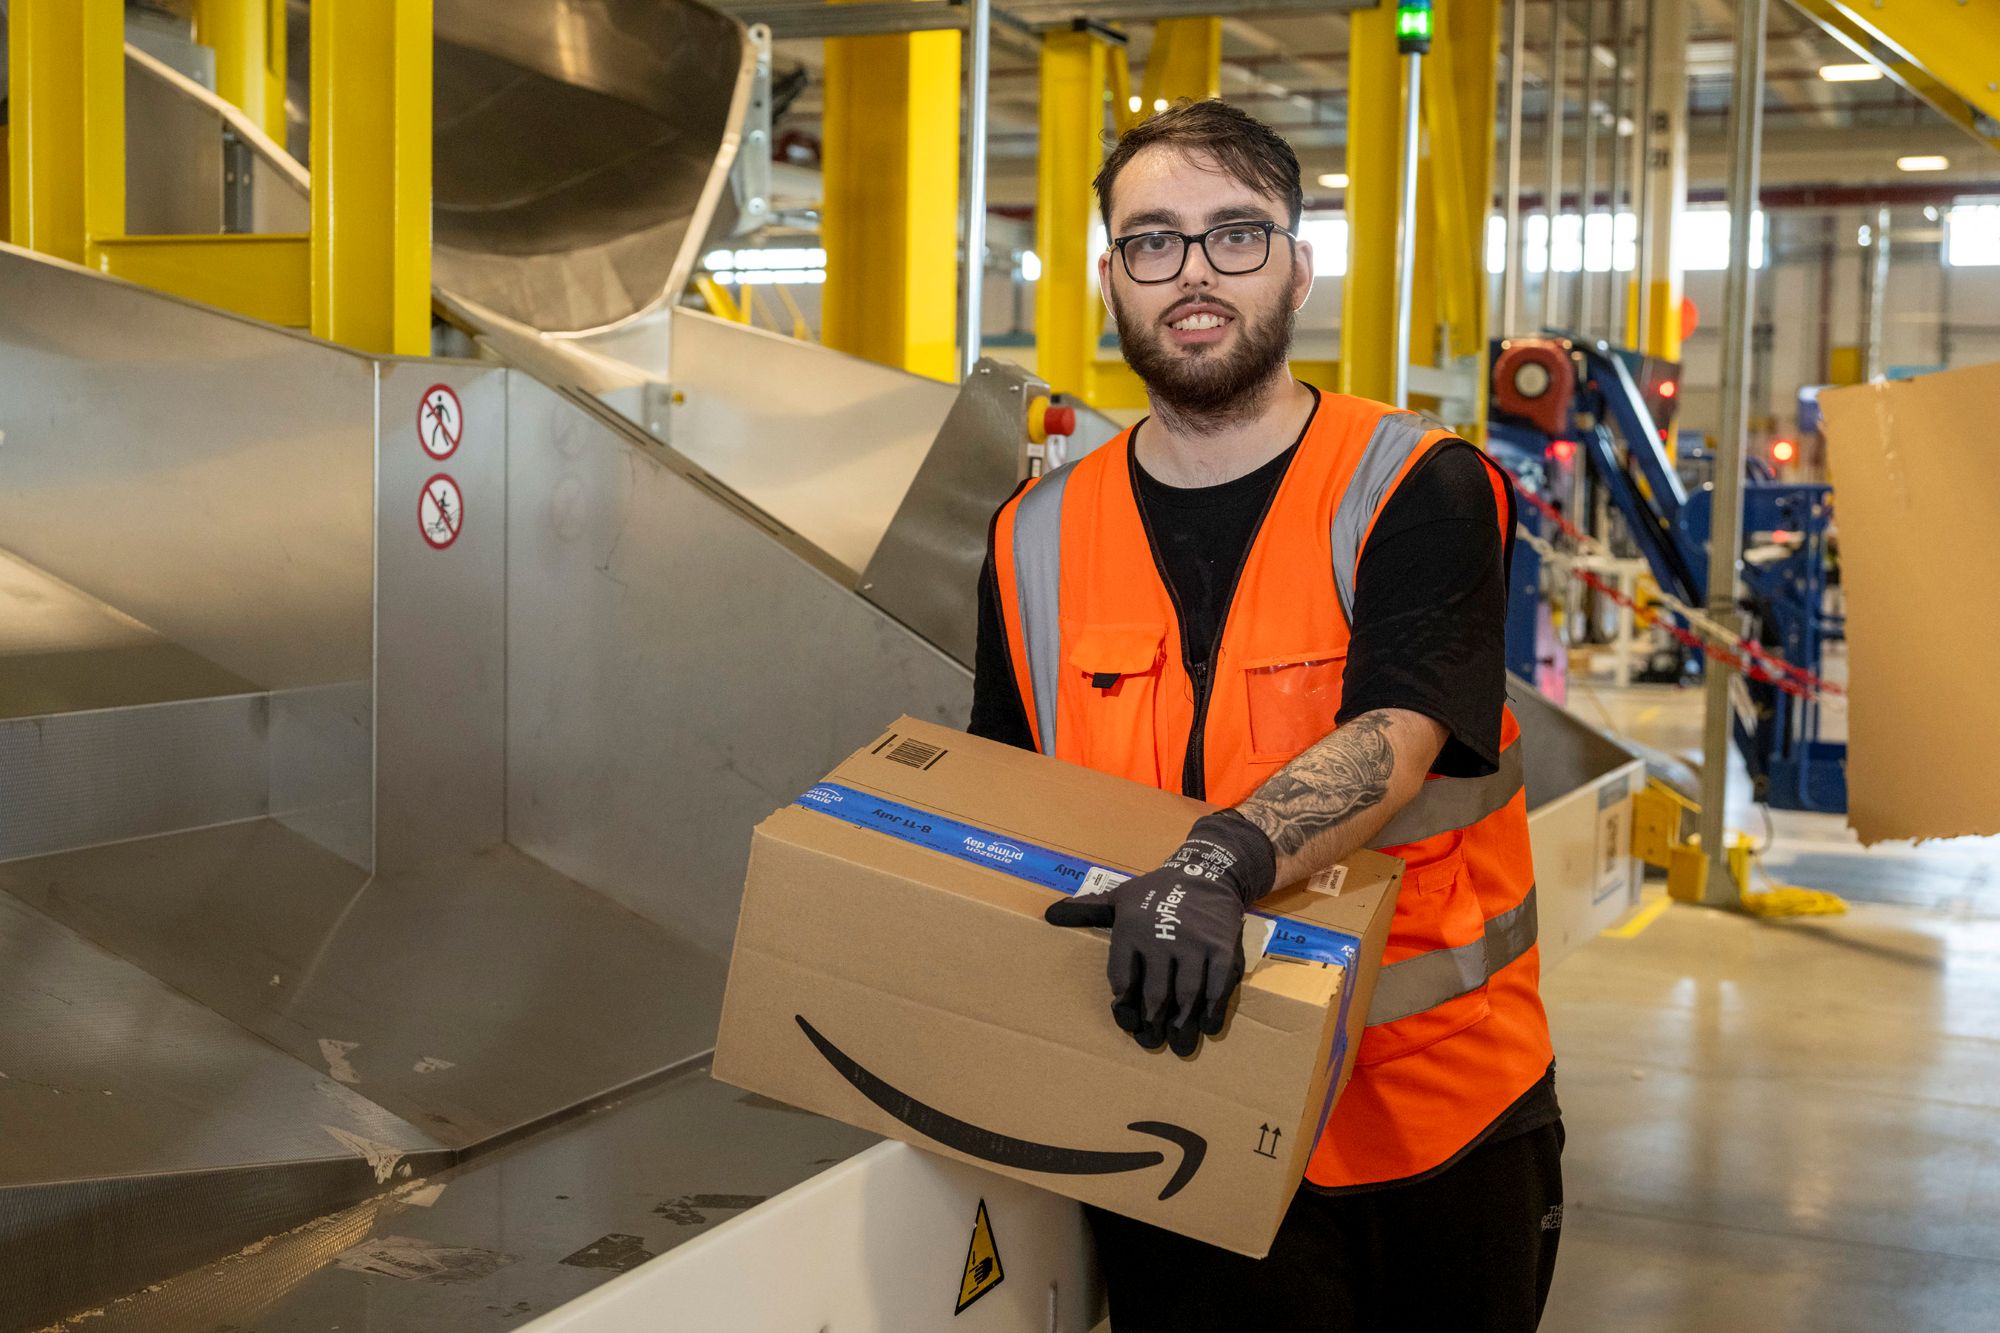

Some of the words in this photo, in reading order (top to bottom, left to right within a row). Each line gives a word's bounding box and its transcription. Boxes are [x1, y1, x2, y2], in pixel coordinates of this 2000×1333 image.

[871, 808, 903, 823] July
[902, 819, 932, 834] 8-11
[963, 836, 986, 850] day
[965, 845, 1013, 864] amazon
[987, 842, 1024, 861] prime
[1053, 863, 1086, 881] July
[1204, 870, 1220, 882] 10
